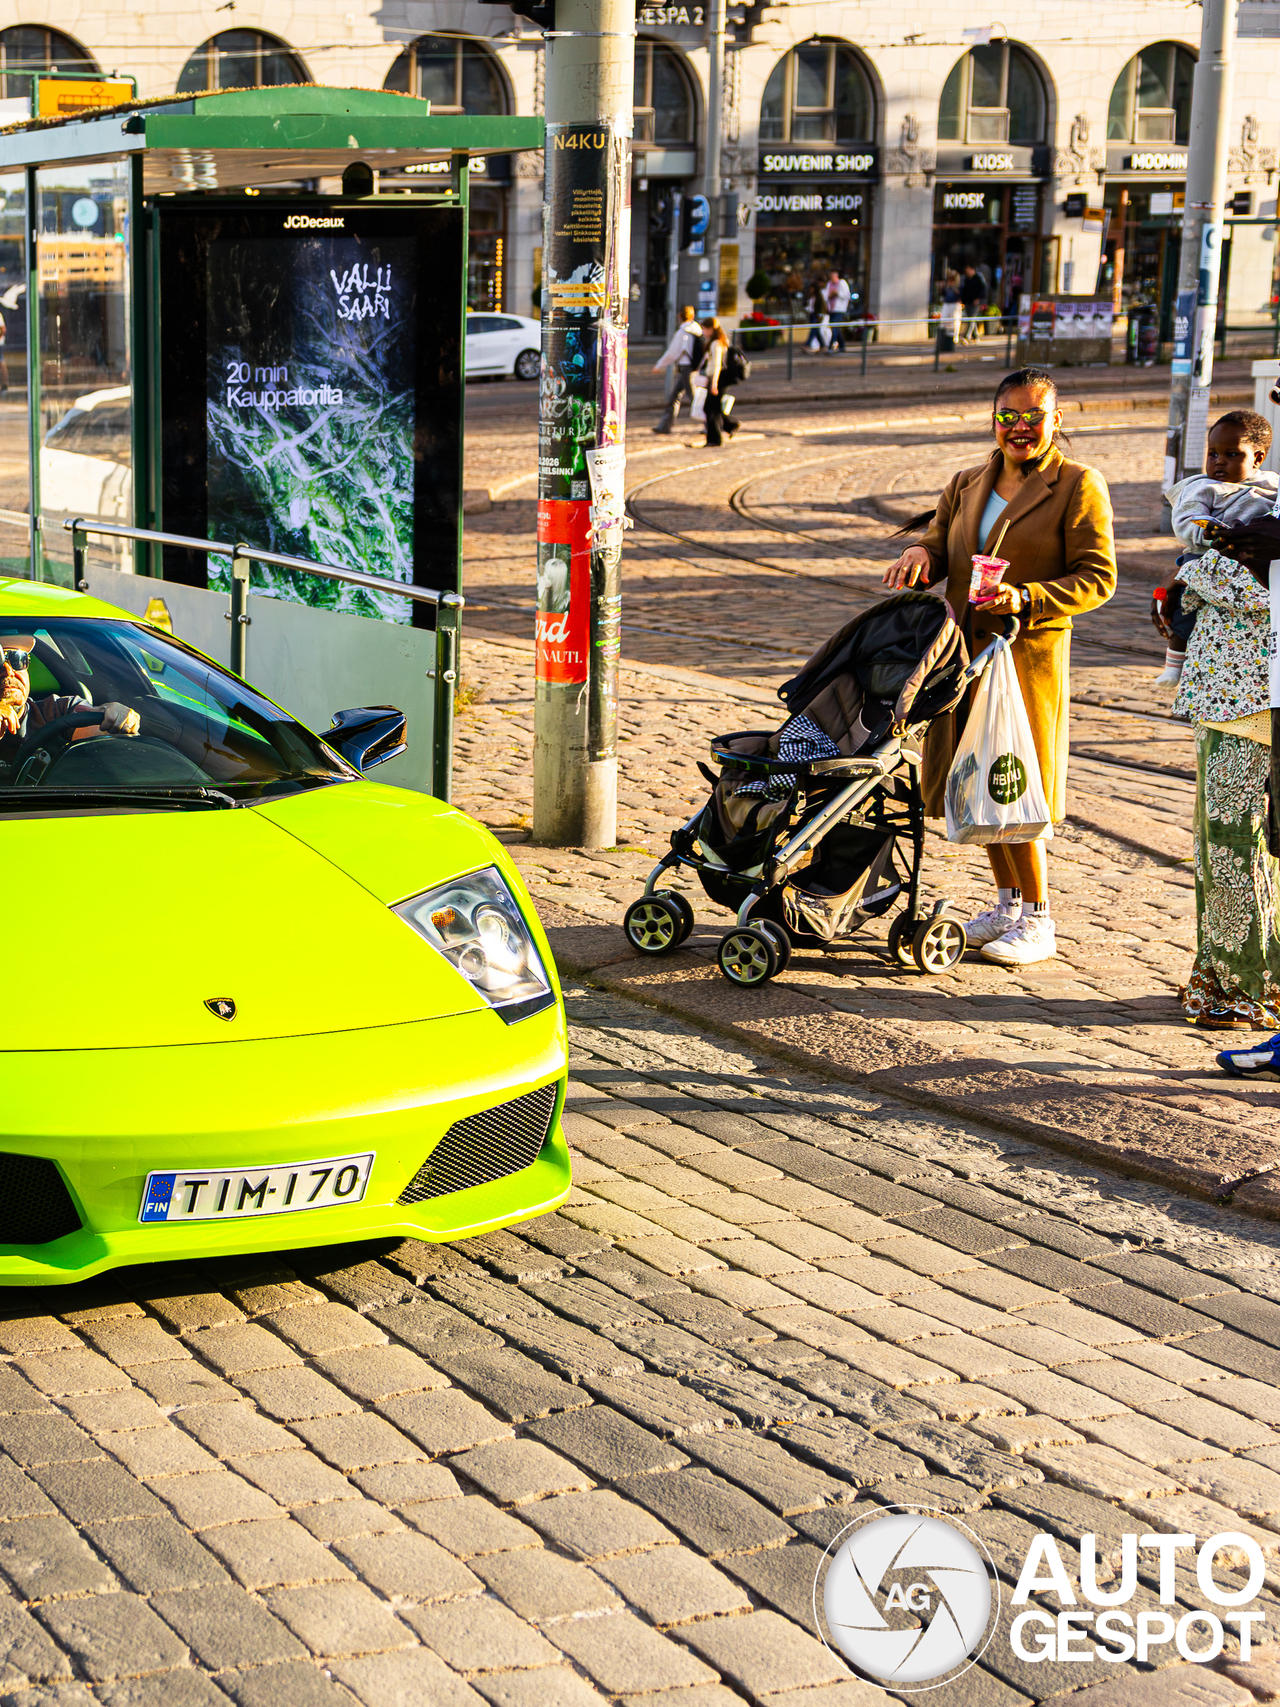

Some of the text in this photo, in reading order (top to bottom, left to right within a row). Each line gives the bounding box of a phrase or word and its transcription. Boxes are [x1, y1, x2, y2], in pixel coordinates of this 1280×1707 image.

[692, 5, 704, 26] 2
[553, 133, 605, 150] N4KU
[763, 154, 874, 172] SOUVENIR SHOP
[972, 153, 1014, 171] KIOSK
[1131, 152, 1188, 170] MOOMIN
[754, 194, 863, 211] SOUVENIR SHOP
[943, 192, 985, 210] KIOSK
[283, 215, 345, 229] JCDecaux
[336, 292, 391, 321] SAARI
[226, 361, 288, 384] 20 min
[226, 383, 344, 412] Kauppatorilta
[541, 466, 575, 476] HELSINKI
[542, 650, 583, 664] NAUTI.
[184, 1164, 360, 1214] TIM-170
[146, 1202, 168, 1213] FIN
